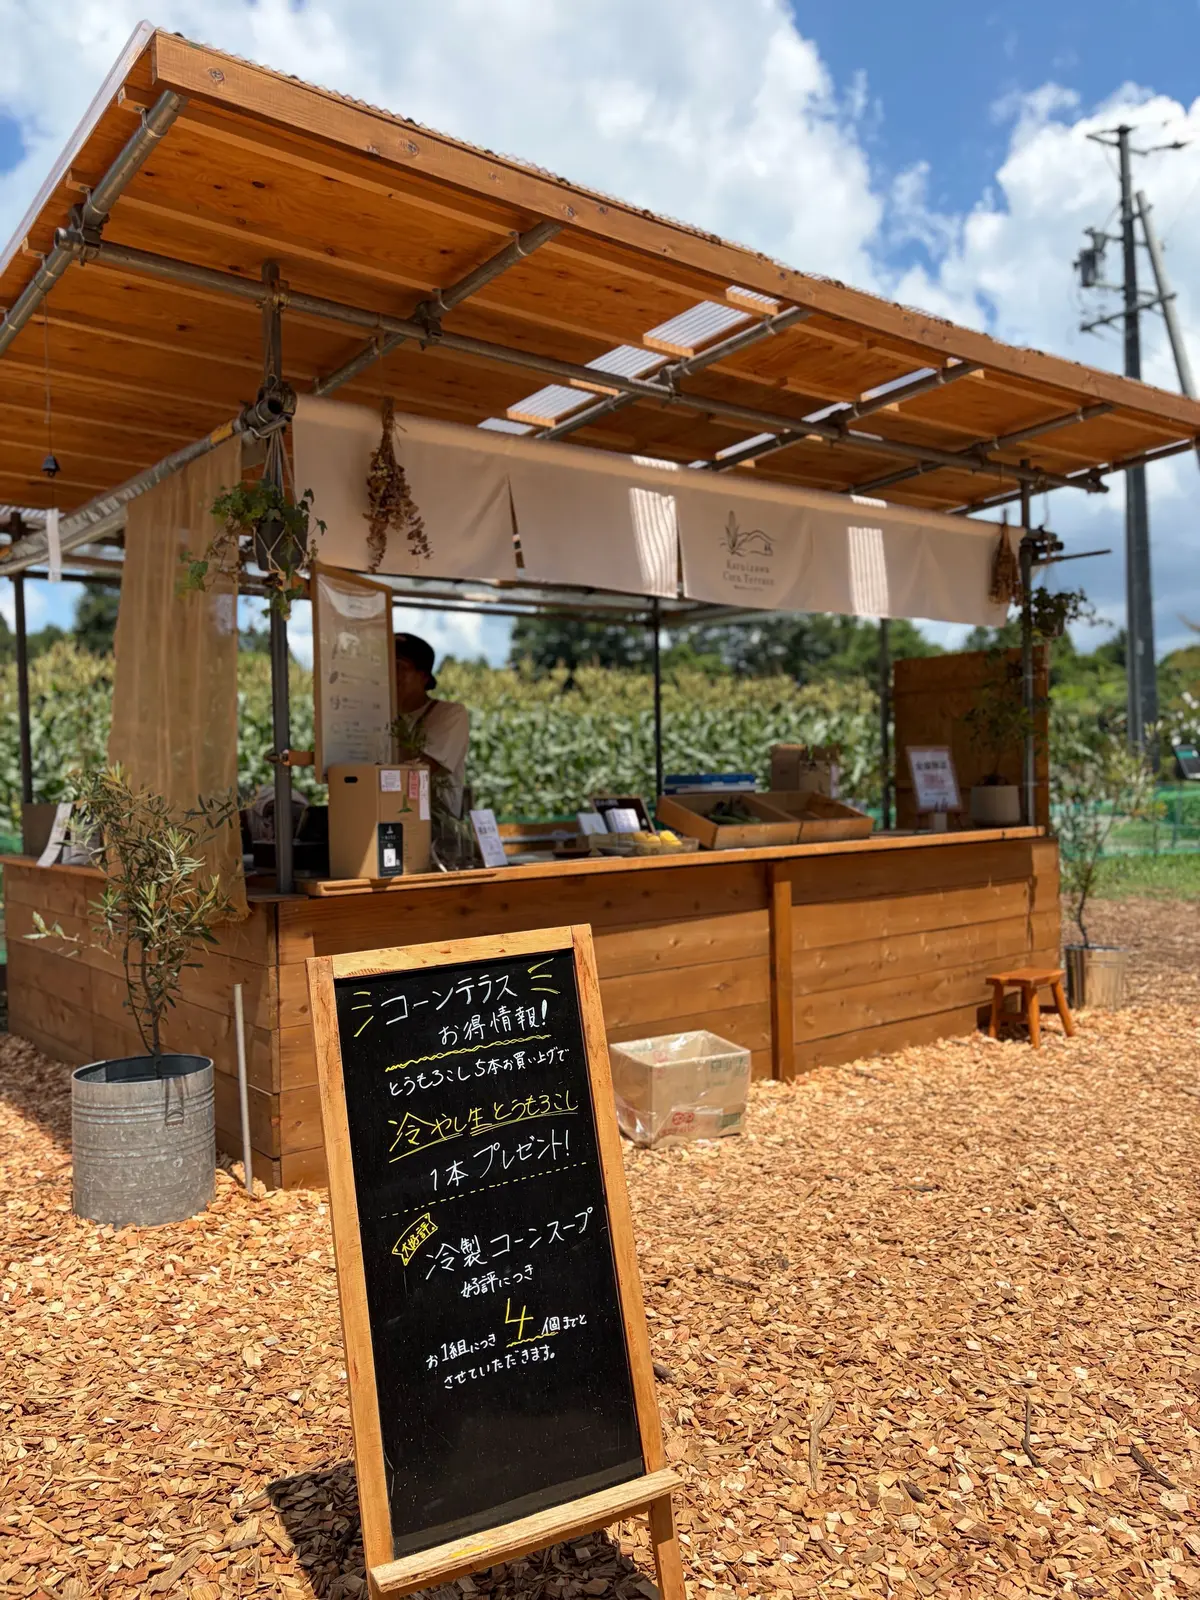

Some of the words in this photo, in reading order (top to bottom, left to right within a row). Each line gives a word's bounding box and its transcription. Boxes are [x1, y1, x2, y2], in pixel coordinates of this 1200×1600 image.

[380, 974, 518, 1026] コーンテラス
[402, 1222, 431, 1258] 大好評
[425, 1206, 594, 1280] 冷製コーンスープ
[460, 1263, 535, 1299] 好評につき
[443, 1344, 556, 1390] させていただきます。
